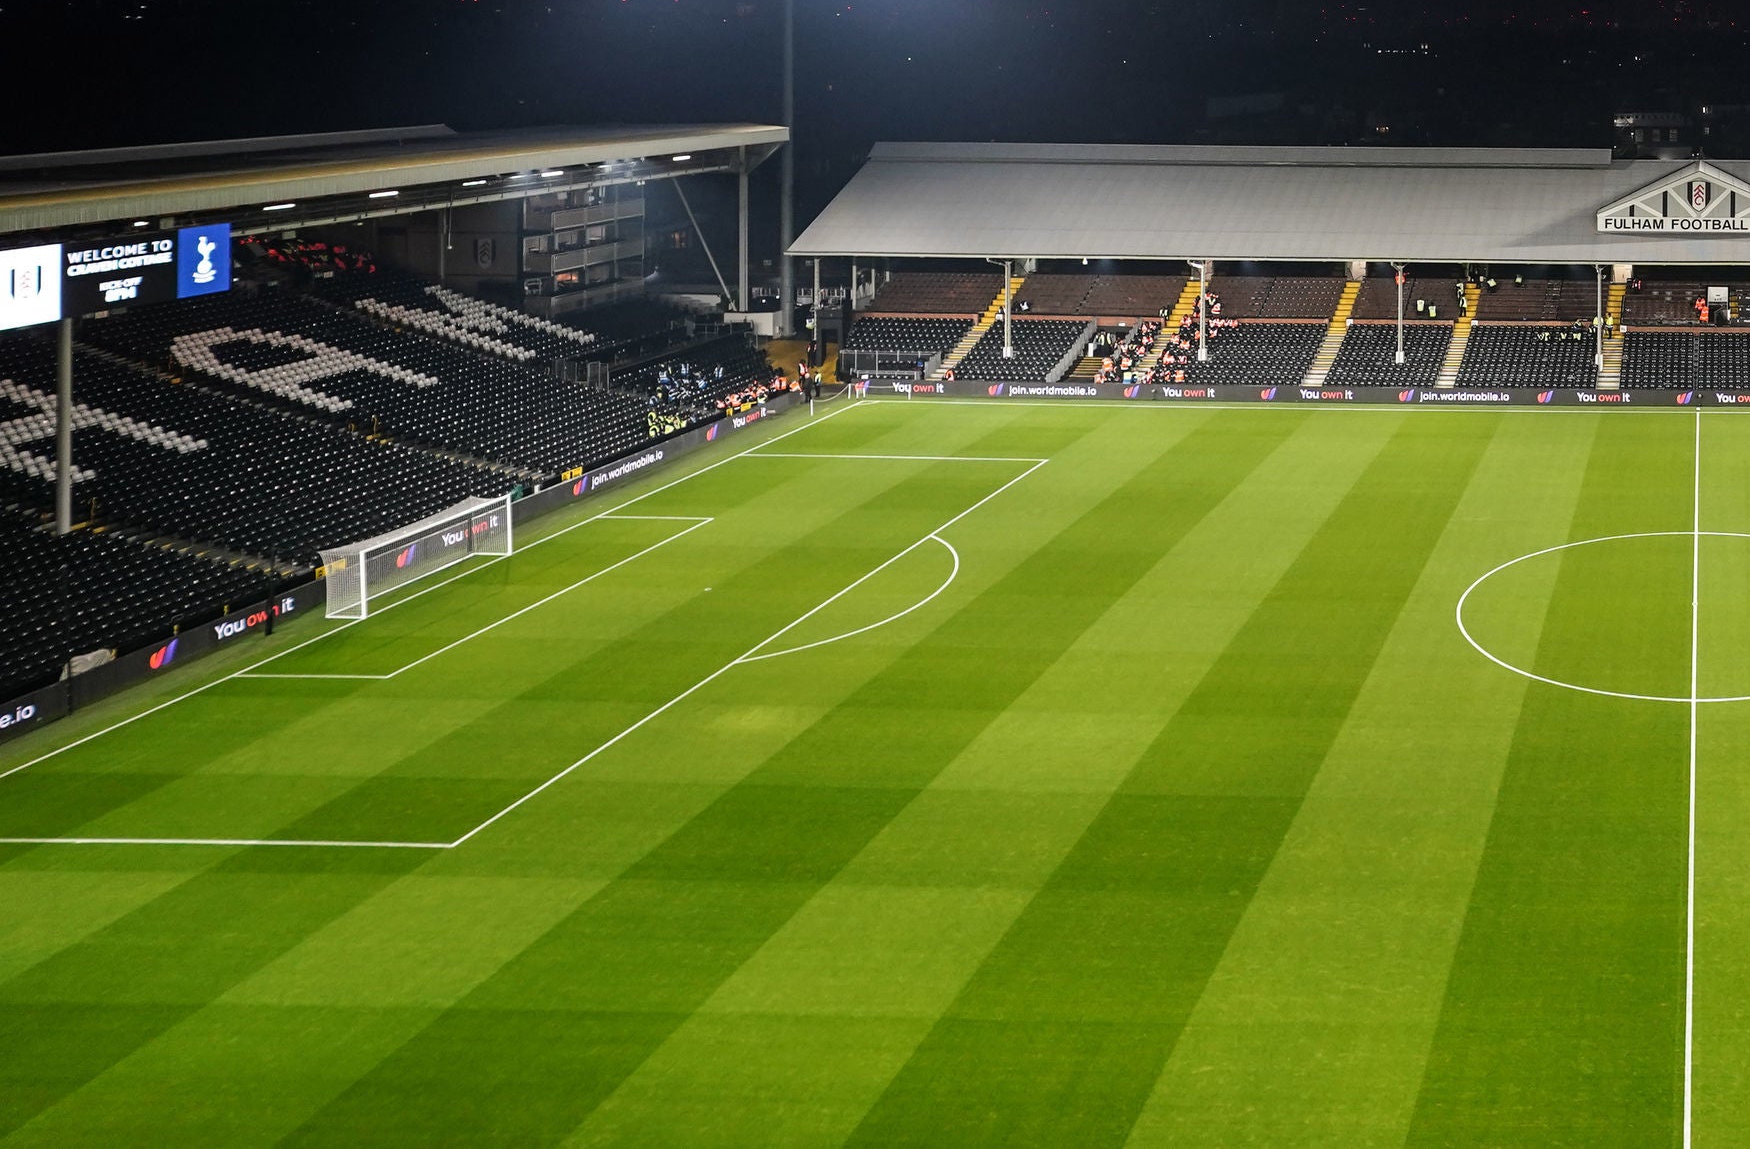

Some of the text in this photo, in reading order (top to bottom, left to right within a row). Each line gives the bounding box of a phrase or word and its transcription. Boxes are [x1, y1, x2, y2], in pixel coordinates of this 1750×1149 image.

[1604, 218, 1664, 230] FULHAM
[1671, 218, 1749, 231] FOOTBALL
[67, 239, 173, 264] WELCOME TO
[891, 382, 944, 393] You own it
[1008, 386, 1097, 397] join.worldmobile.io
[1163, 387, 1215, 398] You own it
[1300, 389, 1353, 400] You own it
[1419, 391, 1509, 402] join.worldmobile.io
[1576, 392, 1630, 402] You own it
[1715, 393, 1735, 403] You
[591, 450, 663, 490] join.worldmobile.io
[442, 530, 465, 547] You
[489, 515, 498, 529] it
[214, 618, 246, 640] You
[281, 597, 295, 614] it
